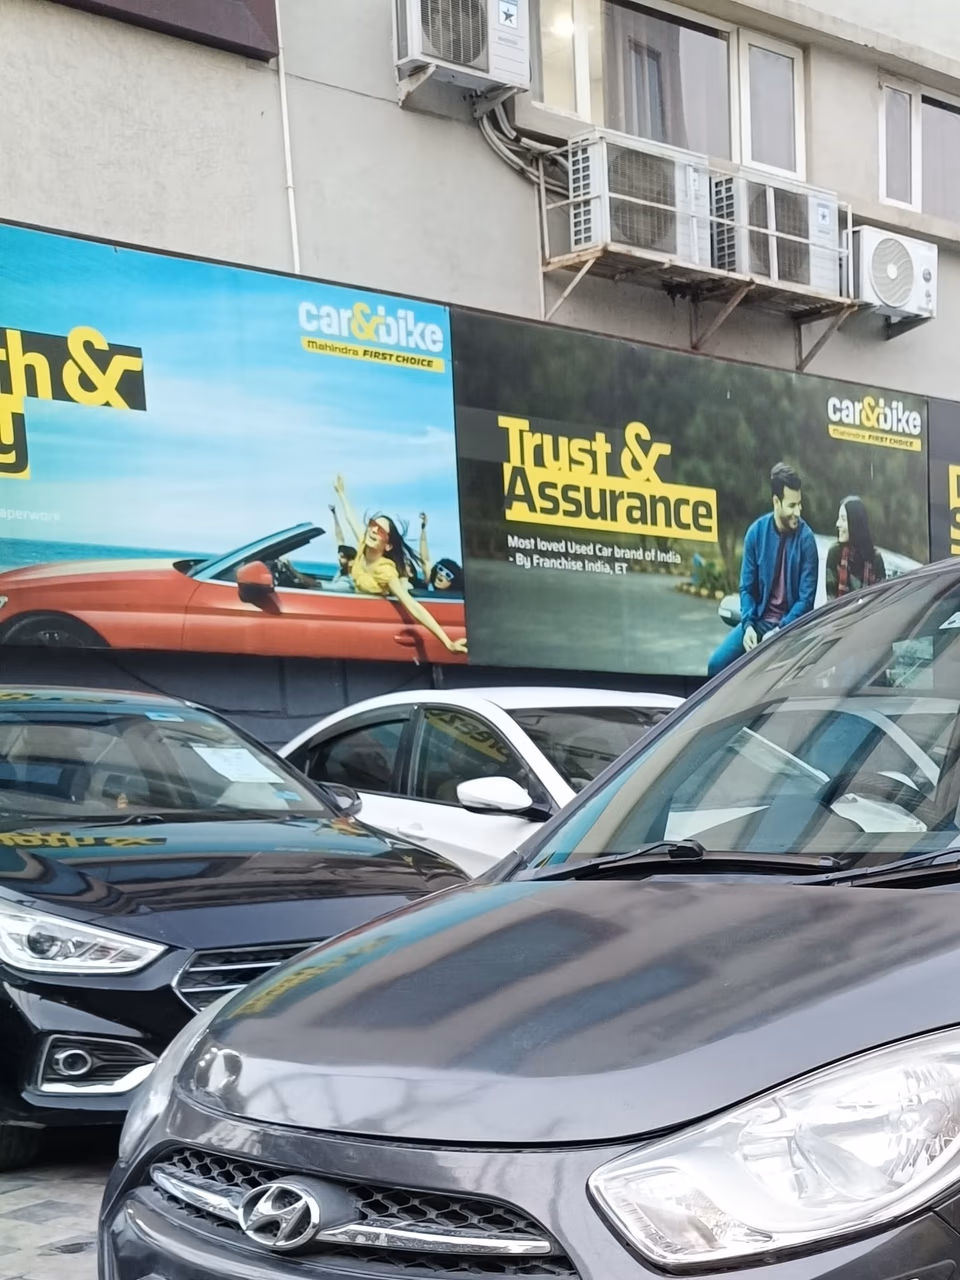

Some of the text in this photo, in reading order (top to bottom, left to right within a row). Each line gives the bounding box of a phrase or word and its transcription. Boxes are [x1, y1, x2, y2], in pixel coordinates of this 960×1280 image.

[298, 302, 443, 352] car&bike
[62, 325, 143, 410] &
[307, 340, 433, 367] Mahindra FIRST CHOICE
[828, 396, 922, 435] car&bike
[498, 416, 671, 483] Trust &
[869, 434, 888, 443] FIRST
[890, 438, 914, 447] CHOICE
[505, 465, 712, 532] Assurance
[507, 535, 681, 563] Most loved Used Car brand of India
[515, 553, 531, 569] By
[533, 555, 583, 571] Franchise
[584, 562, 613, 575] India,
[615, 562, 628, 575] ET
